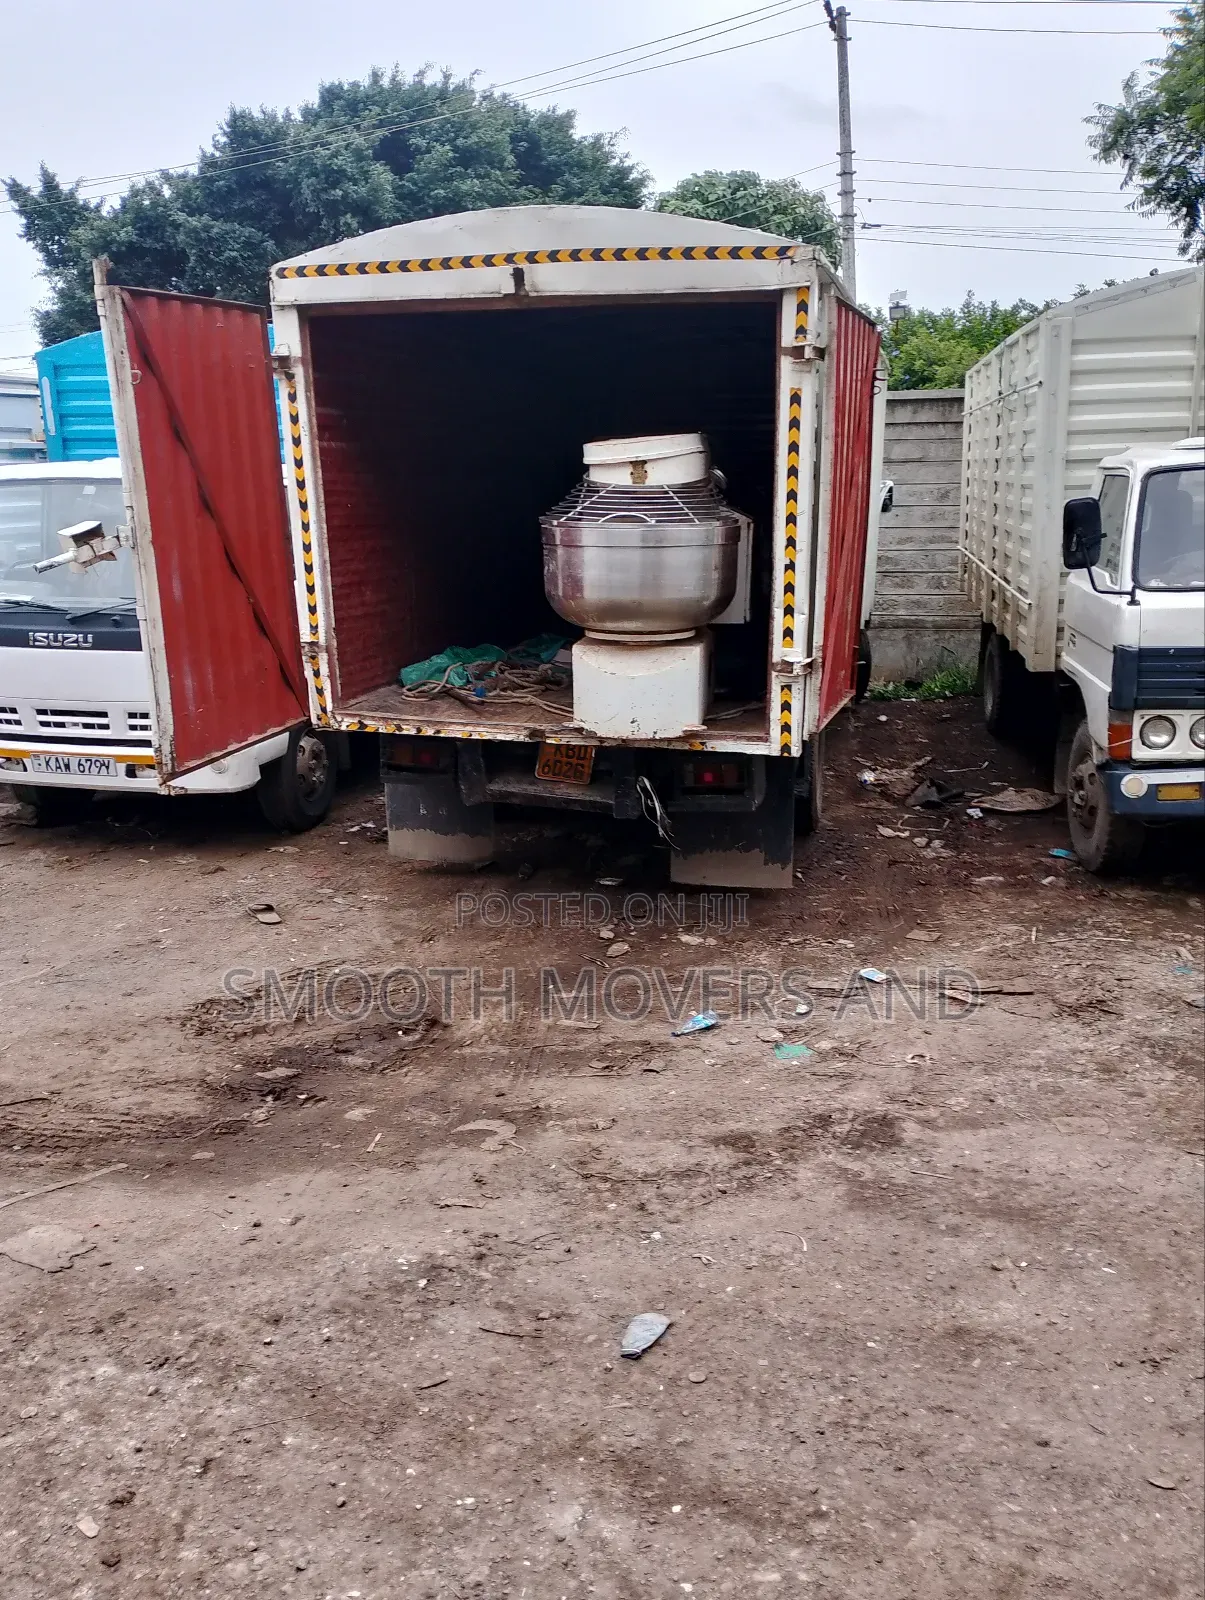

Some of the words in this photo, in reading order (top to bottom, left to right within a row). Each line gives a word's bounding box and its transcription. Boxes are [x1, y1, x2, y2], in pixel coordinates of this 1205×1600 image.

[28, 632, 93, 648] ISUZU
[44, 756, 71, 773] KAW
[77, 758, 111, 775] 679Y
